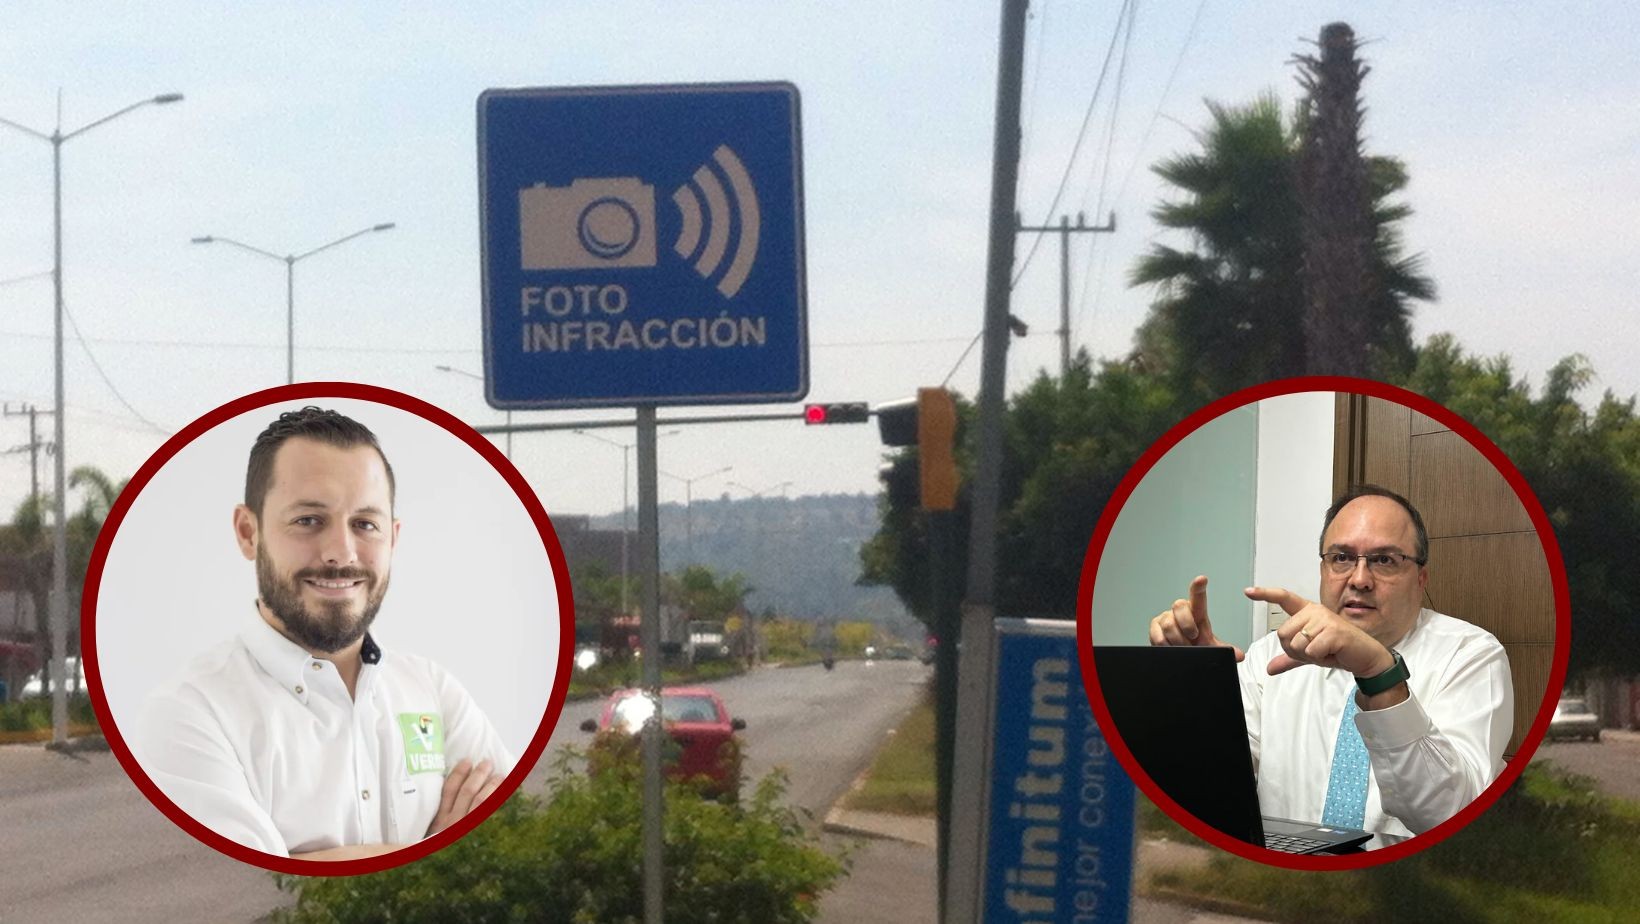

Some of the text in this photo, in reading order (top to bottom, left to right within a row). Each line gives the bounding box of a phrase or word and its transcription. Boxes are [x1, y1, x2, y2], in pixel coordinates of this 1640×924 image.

[521, 284, 628, 316] FOTO
[522, 310, 766, 353] INFRACCIÓN
[1003, 657, 1071, 924] finitum
